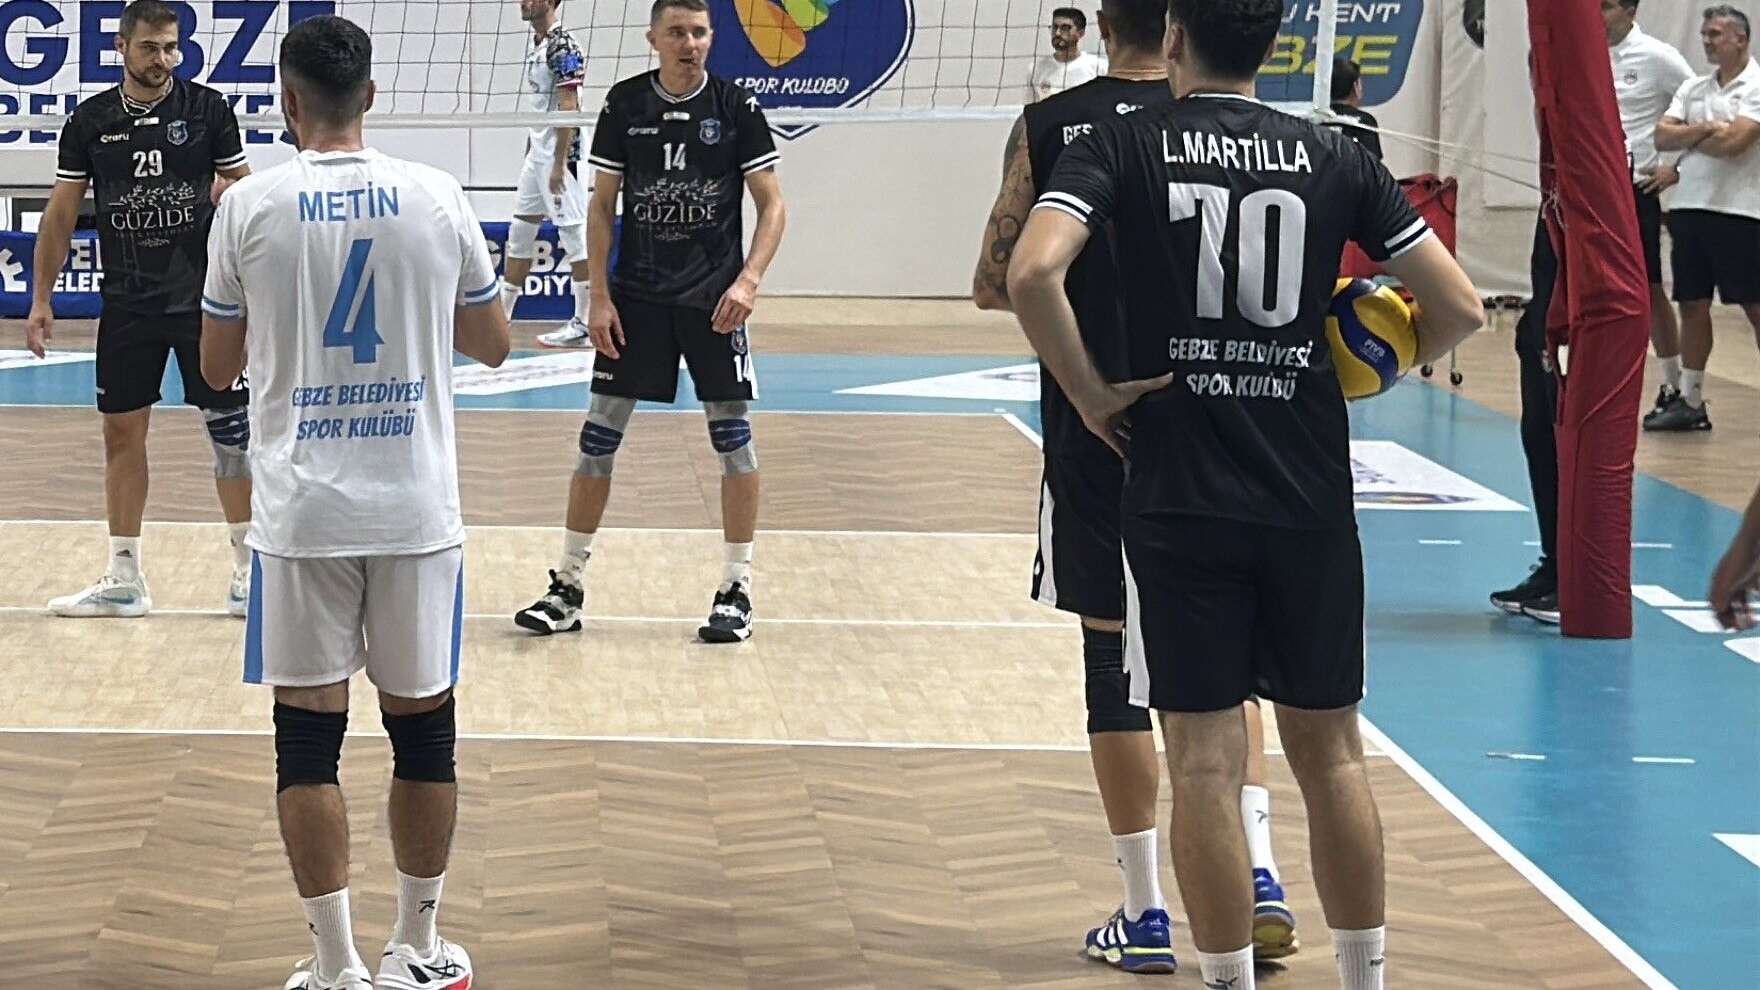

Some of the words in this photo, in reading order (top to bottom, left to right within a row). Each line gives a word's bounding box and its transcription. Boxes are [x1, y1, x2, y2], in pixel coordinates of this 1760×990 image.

[132, 149, 164, 178] 29
[662, 142, 687, 171] 14
[1162, 129, 1312, 174] L.MARTİLLA
[298, 181, 400, 223] METİN
[1168, 181, 1307, 328] 70
[323, 238, 385, 365] 4
[1168, 336, 1220, 361] GEBZE
[336, 374, 426, 407] BELEDİYESİ
[1186, 372, 1234, 397] SPOR
[296, 418, 343, 441] SPOR
[347, 408, 416, 439] KULÜBÜ
